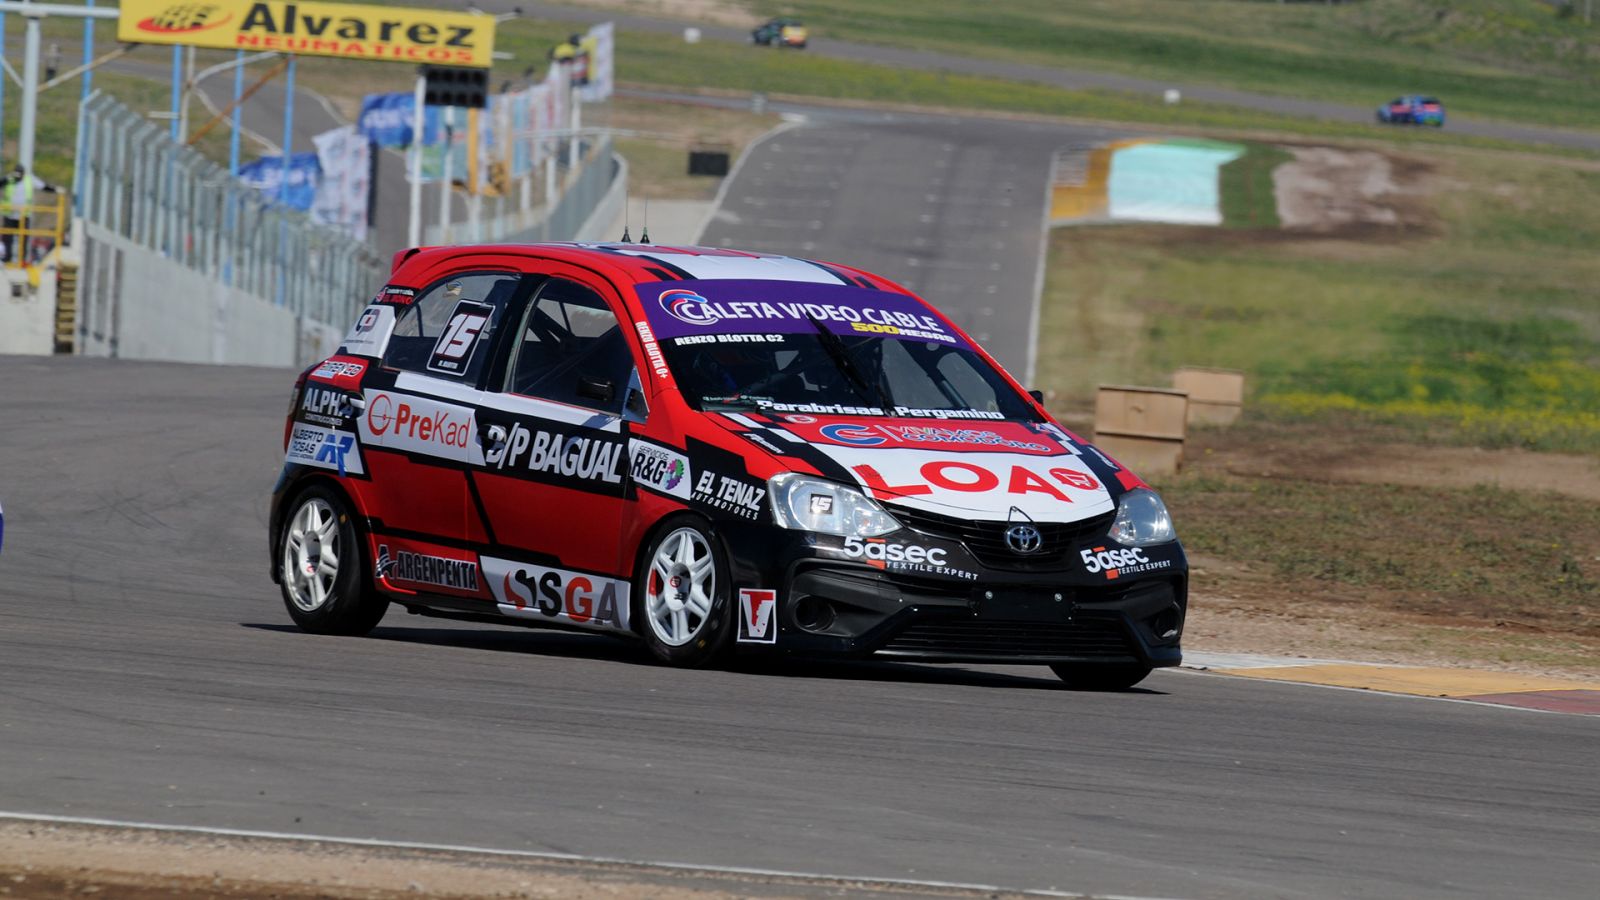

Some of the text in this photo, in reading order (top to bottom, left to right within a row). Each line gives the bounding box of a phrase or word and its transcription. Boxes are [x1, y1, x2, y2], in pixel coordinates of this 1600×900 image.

[240, 1, 475, 48] Alvarez
[236, 34, 474, 64] NEUMATICOS
[680, 301, 945, 333] CALETA VIDEO CABLE
[435, 313, 487, 358] 15
[635, 321, 655, 343] RENZO
[645, 342, 667, 370] BLOTTA
[674, 333, 785, 346] RENZO BLOTTA C2
[756, 400, 1006, 420] Parabrisas Pergamino
[294, 428, 324, 442] ALBERTO
[394, 403, 471, 449] PreKad
[638, 445, 670, 461] SERVICIOS
[902, 432, 1051, 452] COMODORO
[528, 431, 624, 484] BAGUAL
[631, 452, 668, 486] R&G
[696, 470, 766, 511] EL TENAZ
[811, 496, 833, 512] 15
[690, 492, 758, 520] AUTOMOTORES
[843, 536, 948, 567] 5asec
[1080, 547, 1150, 574] 5asec
[397, 551, 480, 591] ARGENPENTA
[886, 561, 979, 581] TEXTILE EXPERT
[1118, 560, 1171, 575] TEXTILE EXPERT
